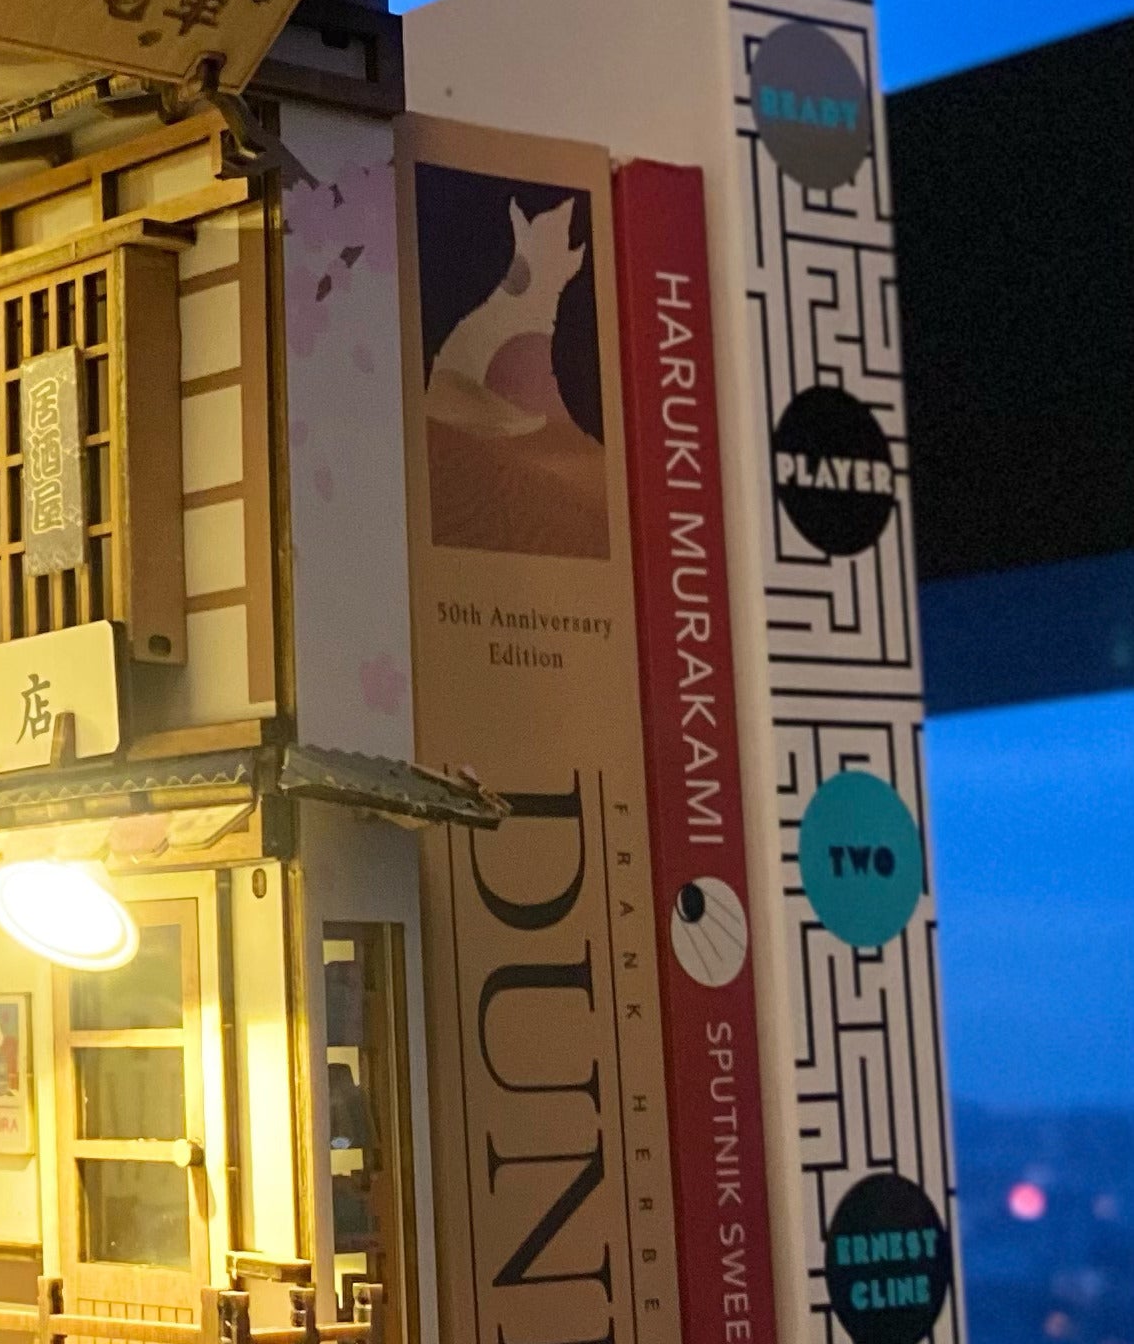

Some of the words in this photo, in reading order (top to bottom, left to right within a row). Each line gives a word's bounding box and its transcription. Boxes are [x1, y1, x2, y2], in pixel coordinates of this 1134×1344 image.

[759, 86, 857, 132] READY
[654, 270, 703, 491] HARUKI
[28, 377, 65, 535] 居酒屋
[776, 452, 894, 494] PLAYER
[437, 601, 482, 628] 50th
[490, 605, 613, 640] Anniversary
[488, 642, 564, 670] Edition
[668, 511, 724, 846] MURAKAMI
[828, 845, 896, 879] TWO
[613, 801, 643, 1020] FRANK
[706, 1020, 743, 1208] SPUTNIK
[836, 1228, 937, 1265] ERNEST
[851, 1275, 930, 1310] CLINE
